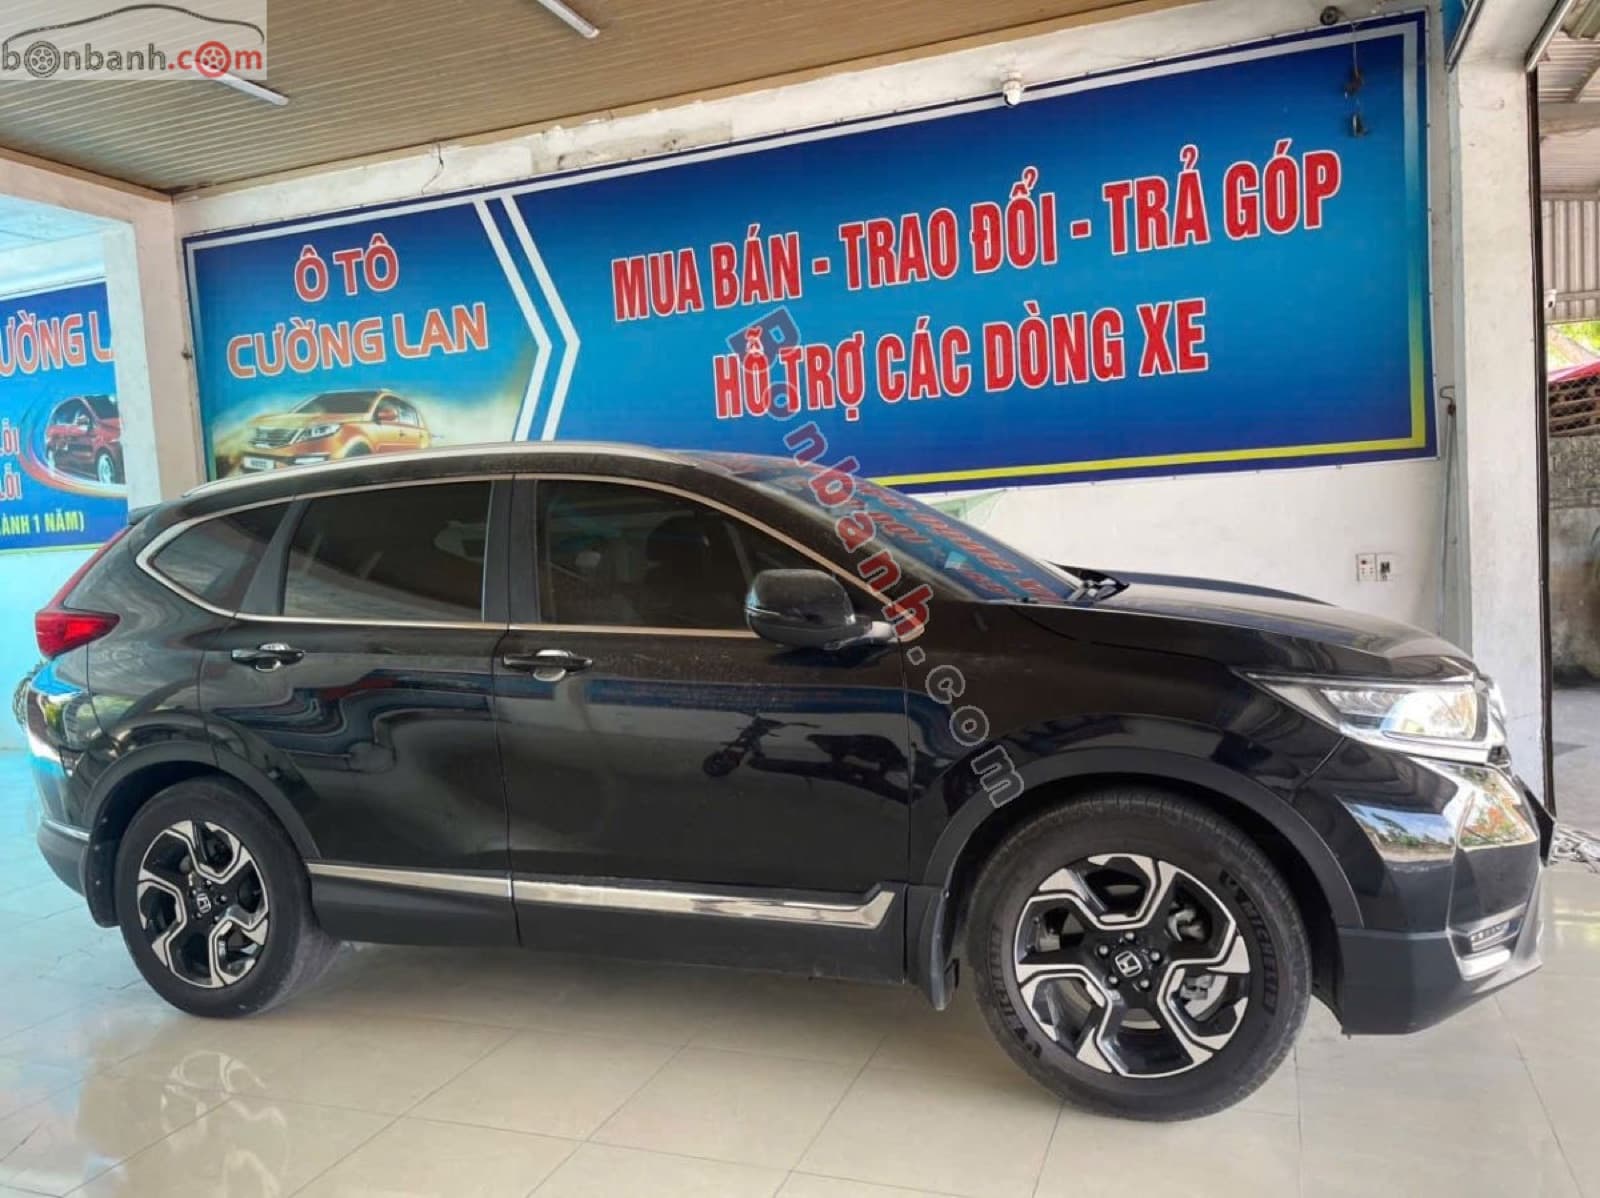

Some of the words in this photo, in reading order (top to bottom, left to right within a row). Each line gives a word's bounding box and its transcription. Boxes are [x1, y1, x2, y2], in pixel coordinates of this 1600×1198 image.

[294, 244, 329, 303] Ô
[332, 232, 400, 297] TÔ
[611, 247, 704, 322] MUA
[710, 223, 802, 309] BÁN
[811, 256, 831, 276] -
[838, 207, 960, 291] TRAO
[969, 165, 1059, 274] ĐỔI
[1069, 219, 1092, 239] -
[1102, 144, 1211, 256] TRẢ
[1222, 138, 1342, 241] GÓP
[0, 309, 87, 377] ƯỜNG
[226, 316, 386, 379] CƯỜNG
[392, 302, 489, 359] LAN
[712, 325, 772, 419] HỖ
[778, 330, 865, 421] TRỢ
[876, 315, 972, 403] CÁC
[982, 300, 1125, 392] DÒNG
[1136, 297, 1209, 377] XE
